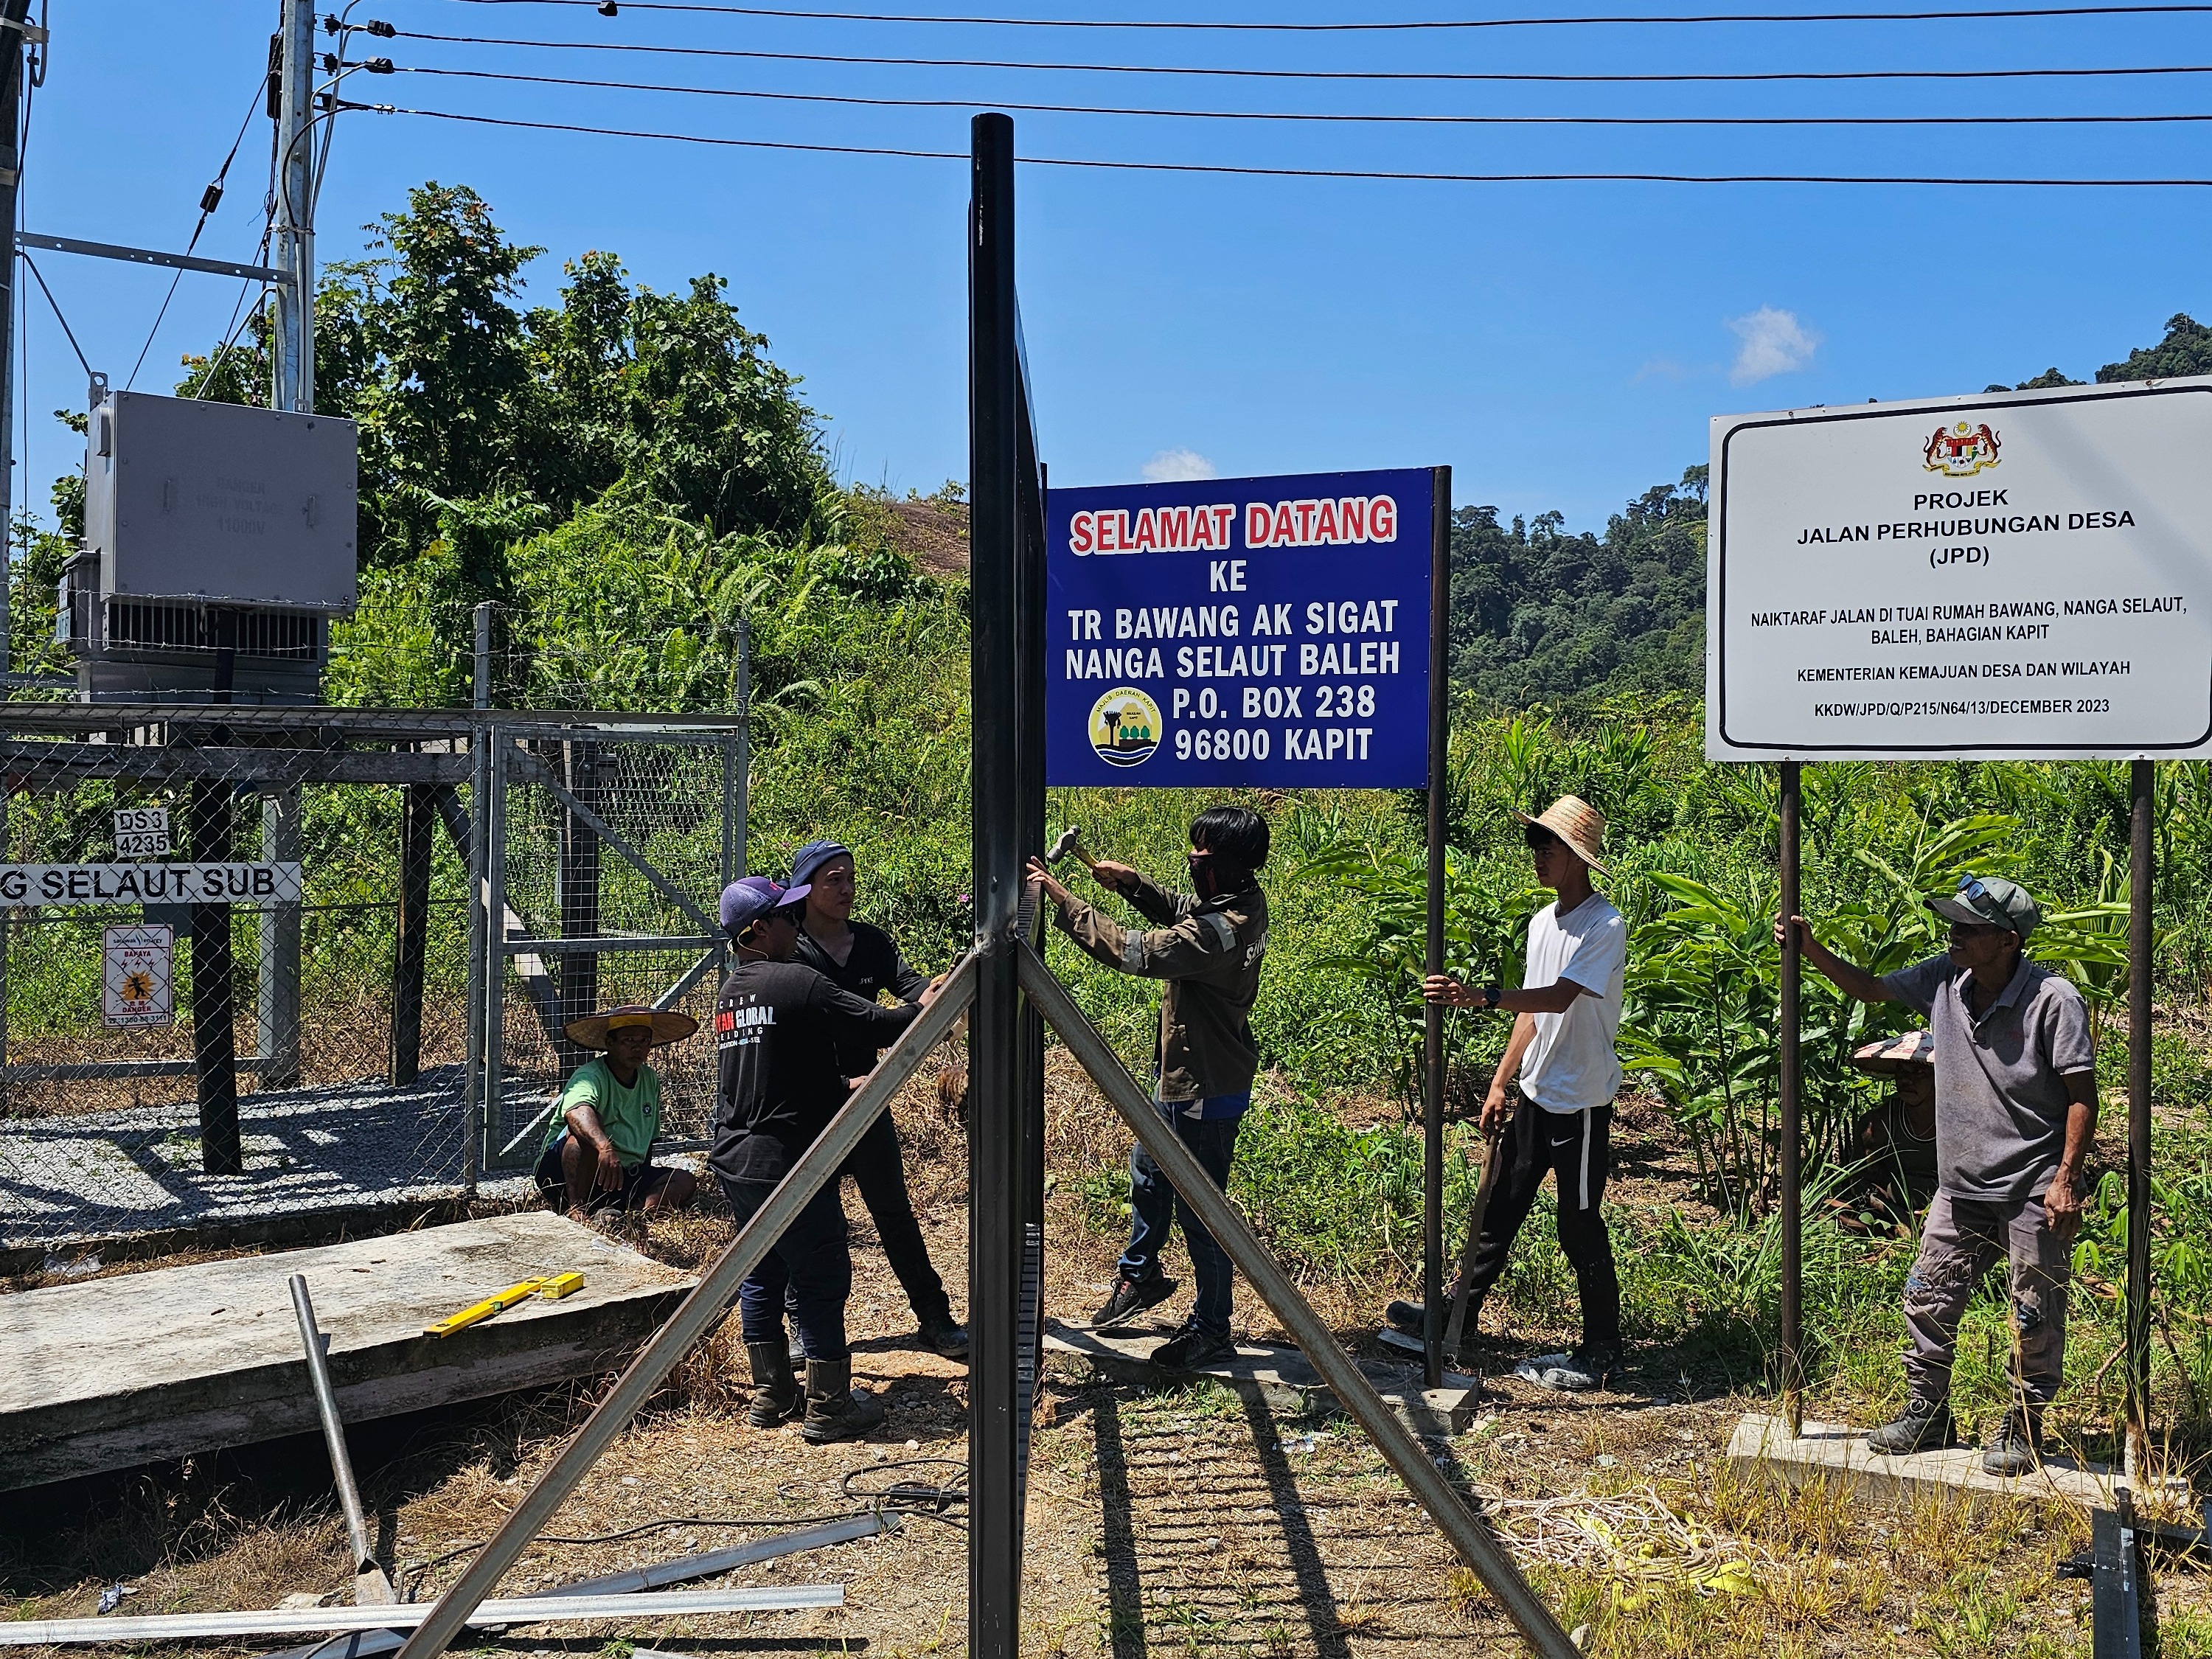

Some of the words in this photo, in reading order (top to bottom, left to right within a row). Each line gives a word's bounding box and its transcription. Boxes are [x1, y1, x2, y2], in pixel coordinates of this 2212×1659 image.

[1915, 490, 2008, 510] PROJEK
[1069, 504, 1236, 556] SELAMAT
[1245, 495, 1397, 549] DATANG
[1798, 526, 1868, 544] JALAN
[1878, 515, 2059, 540] PERHUBUNGAN
[2069, 511, 2135, 529] DESA
[1930, 546, 1989, 568] (JPD)
[1211, 560, 1246, 591] KE
[1068, 610, 1102, 640] TR
[1116, 605, 1238, 639] BAWANG
[1252, 604, 1292, 636] AK
[1306, 600, 1398, 634] SIGAT
[1752, 611, 1826, 627] NAIKTARAF
[1831, 608, 1874, 624] JALAN
[1880, 608, 1892, 622] DI
[1896, 607, 1927, 621] TUAI
[1933, 605, 1984, 619] RUMAH
[1990, 602, 2059, 618] BAWANG,
[2065, 599, 2118, 615] NANGA
[2123, 597, 2186, 614] SELAUT,
[1872, 629, 1921, 645] BALEH,
[1927, 626, 2001, 642] BAHAGIAN
[2007, 625, 2049, 639] KAPIT
[1067, 648, 1164, 679] NANGA
[1177, 645, 1286, 678] SELAUT
[1301, 641, 1399, 675] BALEH
[1798, 667, 1894, 681] KEMENTERIAN
[1900, 665, 1977, 679] KEMAJUAN
[1983, 664, 2021, 677] DESA
[2027, 663, 2056, 676] DAN
[2062, 661, 2129, 675] WILAYAH
[1142, 698, 1156, 712] KAPIT
[1174, 688, 1226, 718] P.O.
[1243, 686, 1302, 717] BOX
[1316, 685, 1374, 717] 238
[1815, 700, 2072, 716] KKDW/JPD/Q/P215/N64/13/DECEMBER
[2077, 699, 2109, 712] 2023
[1175, 729, 1269, 759] 96800
[1285, 728, 1372, 759] KAPIT
[120, 835, 167, 853] 4235
[41, 869, 191, 900] SELAUT
[203, 869, 275, 897] SUB
[719, 994, 757, 1009] CREW
[735, 1006, 777, 1029] GLOBAL
